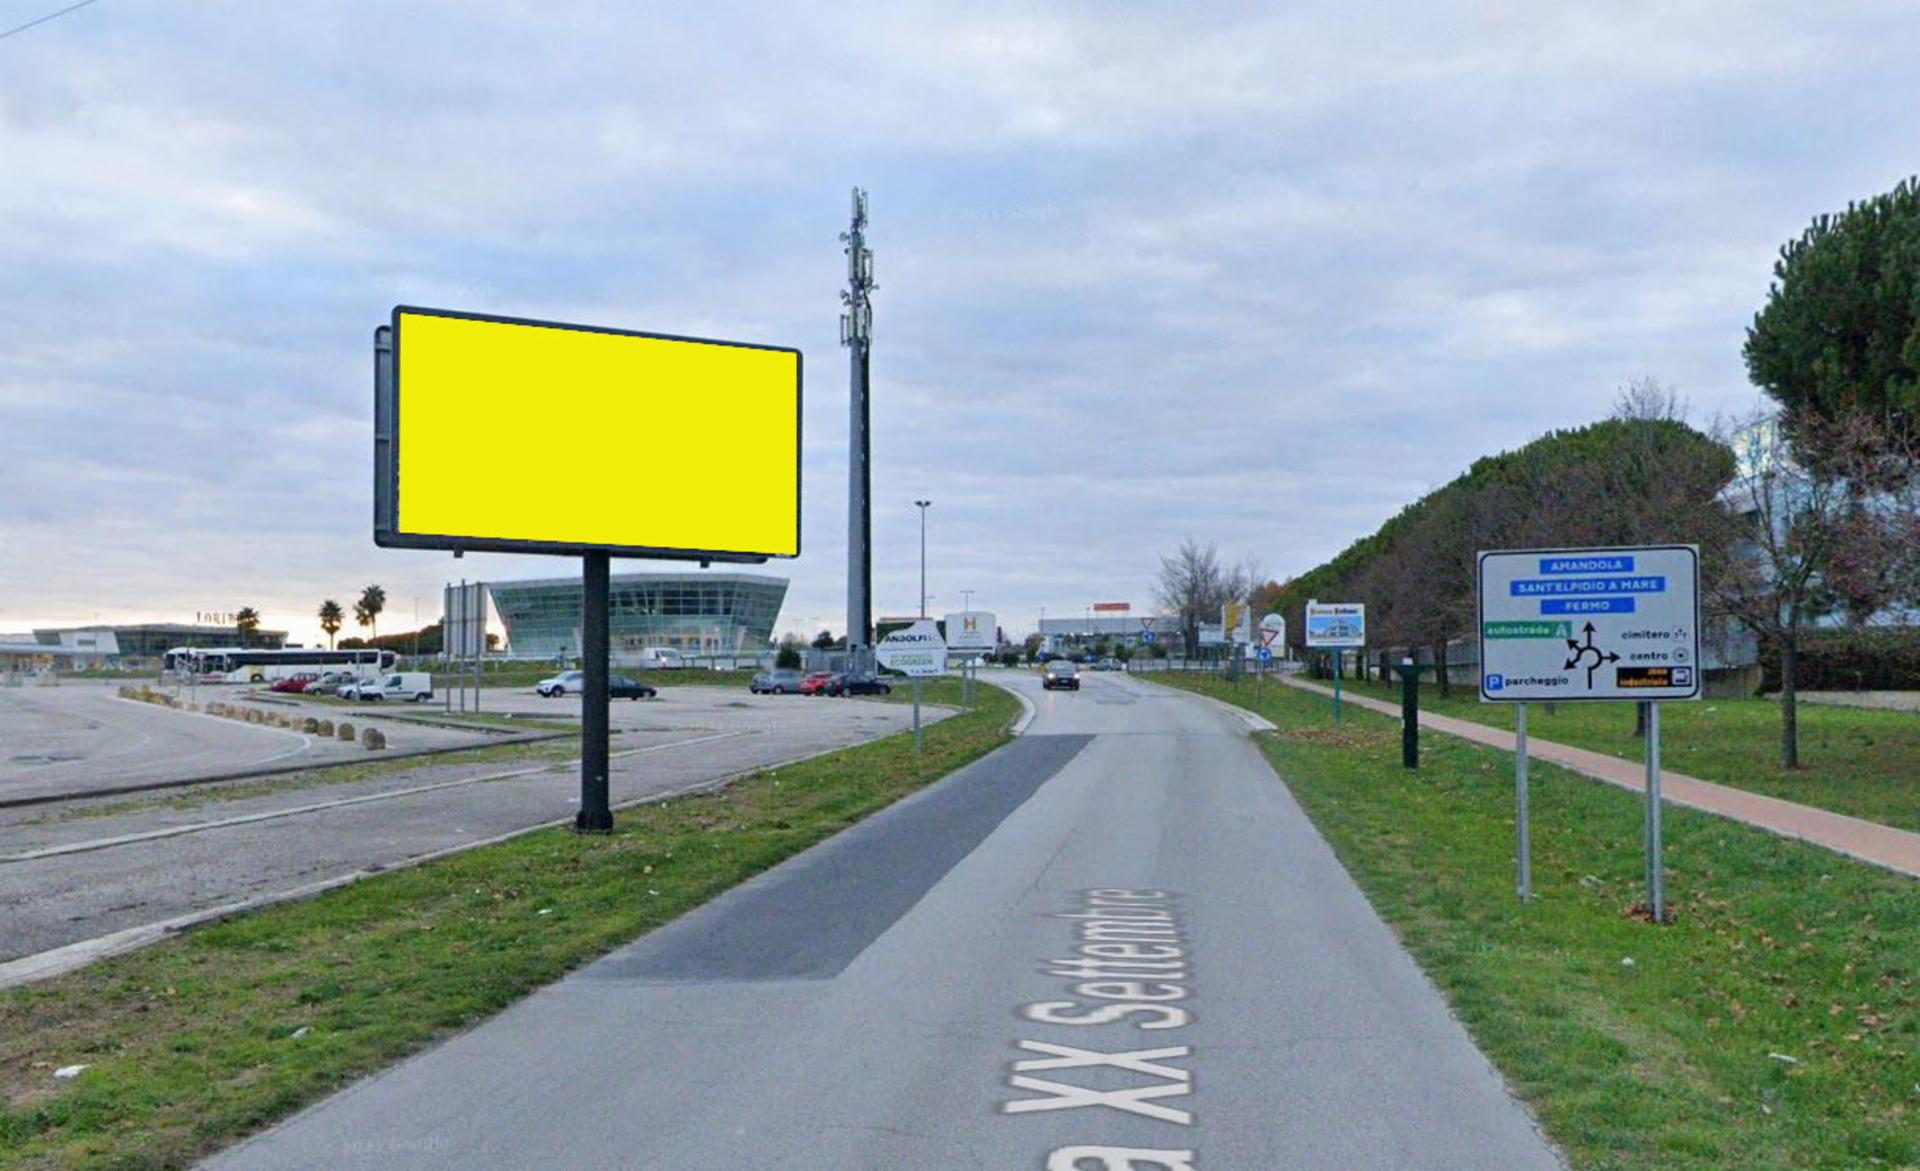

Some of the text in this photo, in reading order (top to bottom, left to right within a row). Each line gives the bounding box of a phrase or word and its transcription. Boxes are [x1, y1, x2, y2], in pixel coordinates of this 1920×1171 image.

[1551, 560, 1622, 571] AMANDOLA
[1608, 581, 1618, 591] A
[1621, 579, 1658, 590] MARE
[1565, 601, 1610, 612] FERMO
[1487, 625, 1550, 635] autostrada
[1621, 629, 1670, 640] cimitero
[1629, 651, 1668, 660] centro
[1505, 675, 1569, 687] parcheggio
[1024, 889, 1187, 1029] Settembre
[1006, 1039, 1191, 1125] XX
